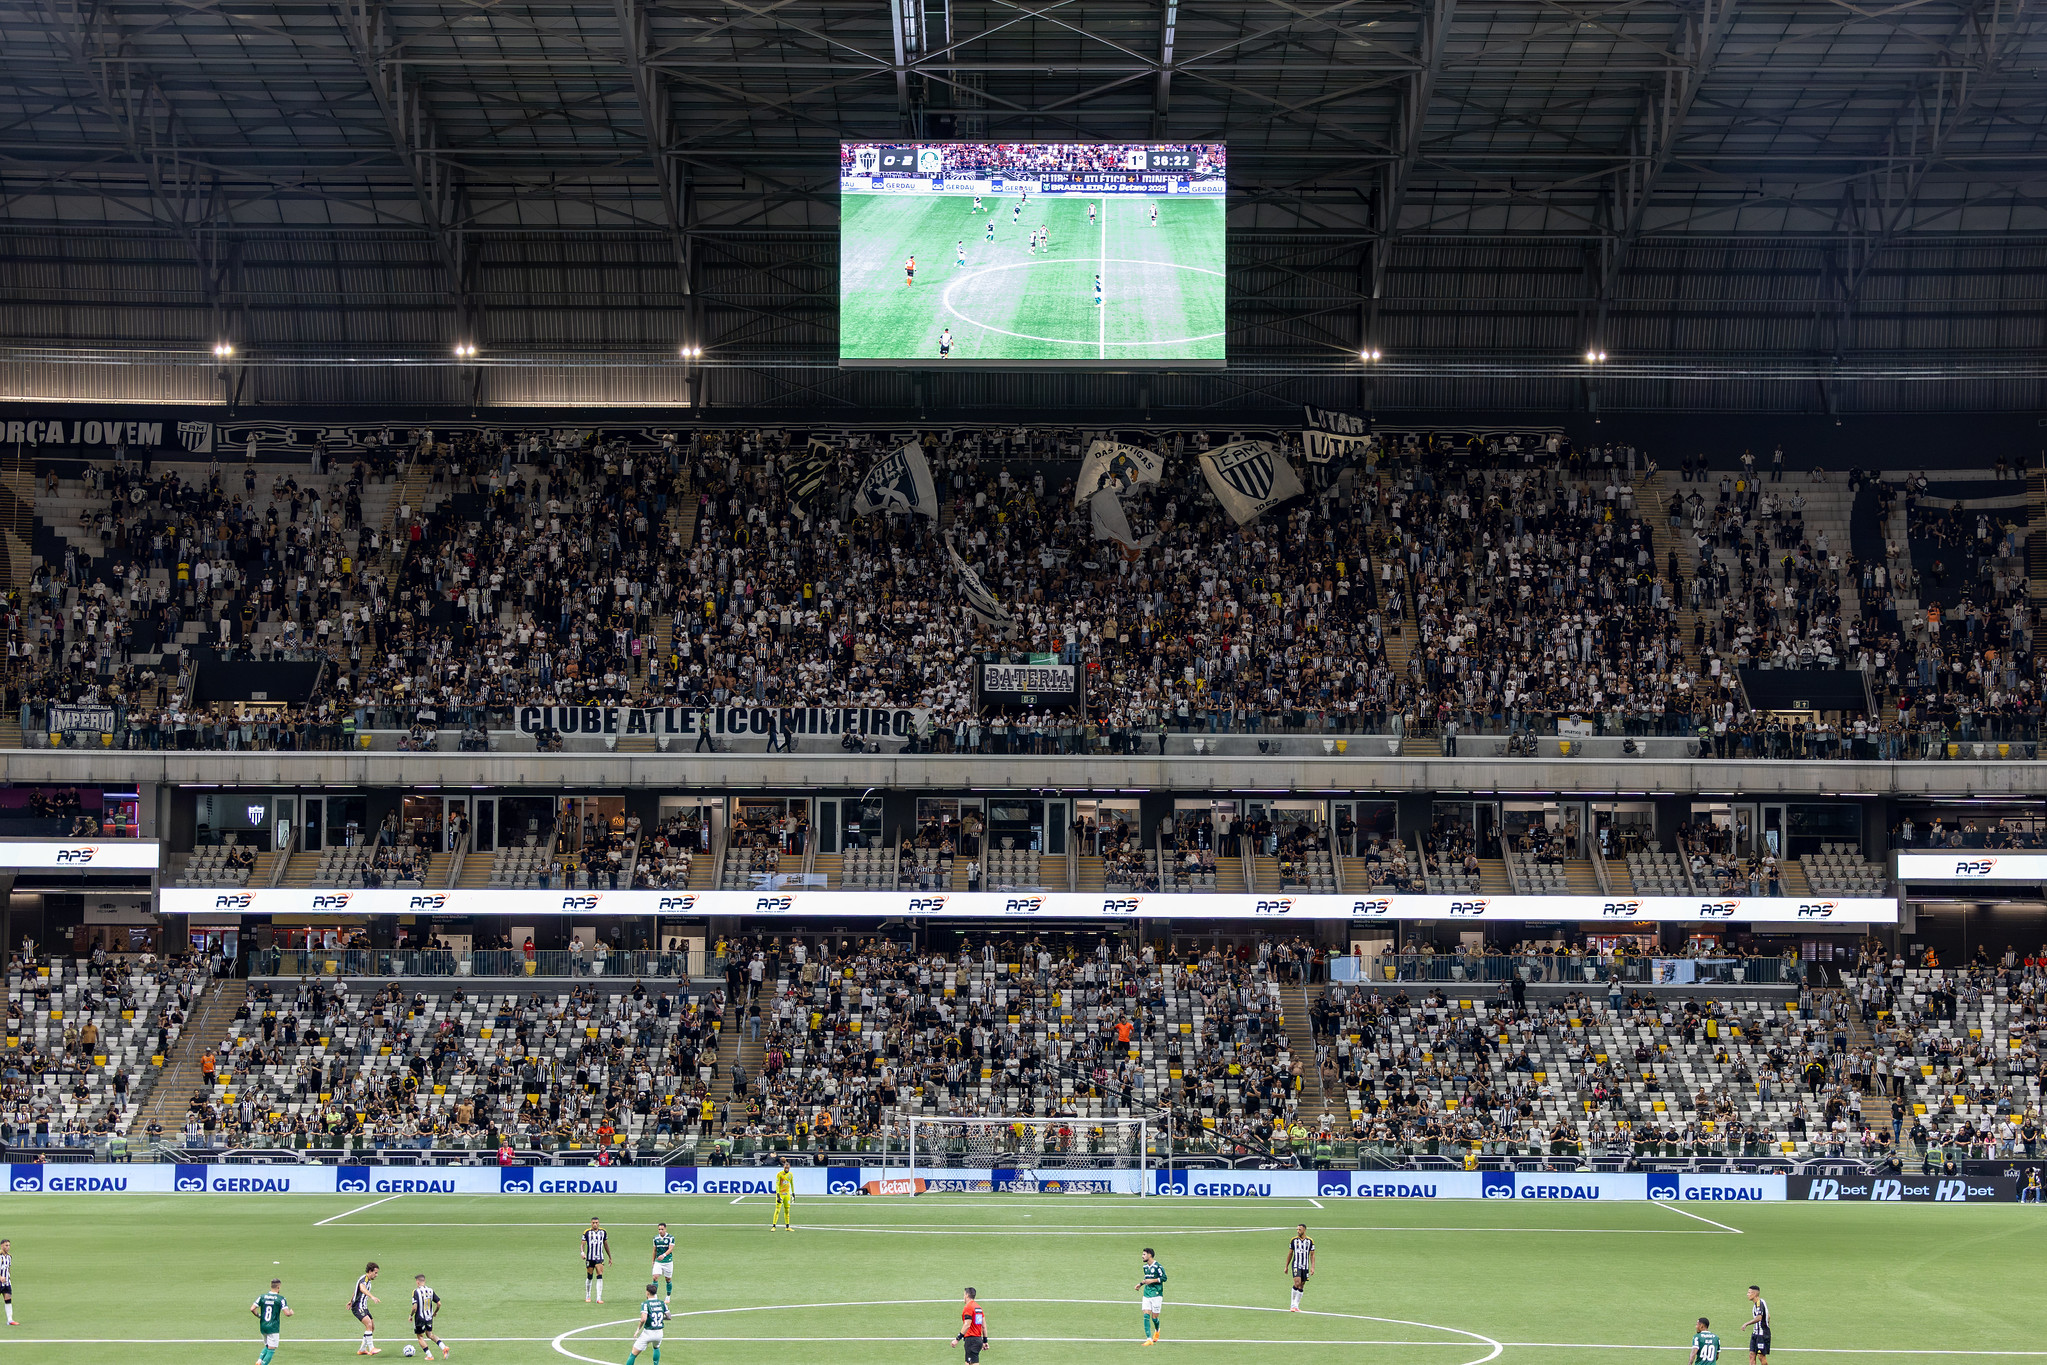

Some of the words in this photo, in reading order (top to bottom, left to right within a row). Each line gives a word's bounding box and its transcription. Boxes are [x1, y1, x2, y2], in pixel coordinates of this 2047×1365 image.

[1152, 155, 1190, 166] 36:22
[1051, 182, 1118, 192] BRASILEIRÃO
[0, 421, 64, 447] RÇA
[70, 421, 163, 446] JOVEM
[1095, 446, 1114, 459] DAS
[1117, 444, 1154, 471] ANTIGAS
[1221, 442, 1260, 466] CAM
[987, 667, 1073, 691] BATERIA
[520, 707, 618, 734] CLUBE
[57, 850, 94, 862] APS
[1955, 862, 1993, 874] APS
[215, 895, 252, 908] APS
[312, 896, 349, 908] APS
[409, 896, 446, 909] APS
[562, 897, 599, 909] APS
[659, 897, 696, 910] APS
[756, 898, 793, 910] APS
[909, 899, 945, 911] APS
[1005, 899, 1042, 912] APS
[1103, 900, 1139, 912] APS
[1256, 901, 1292, 913] APS
[1353, 901, 1389, 914] APS
[1450, 902, 1486, 915] APS
[1603, 903, 1639, 916] APS
[1700, 904, 1736, 916] APS
[1798, 904, 1834, 917] APS
[49, 1177, 127, 1192] GERDAU
[213, 1178, 290, 1192] GERDAU
[376, 1179, 455, 1193] GERDAU
[539, 1180, 618, 1194] GERDAU
[1193, 1182, 1271, 1197] GERDAU
[1357, 1183, 1437, 1198] GERDAU
[1808, 1179, 1839, 1200] H2
[1840, 1185, 1868, 1195] bet
[1870, 1179, 1902, 1201] H2
[1903, 1185, 1930, 1196] bet
[1934, 1180, 1966, 1201] H2
[1967, 1185, 1995, 1196] bet
[1521, 1185, 1600, 1200] GERDAU
[1685, 1186, 1763, 1201] GERDAU
[264, 1305, 273, 1322] 8
[651, 1311, 664, 1327] 32
[1699, 1344, 1716, 1362] 40
